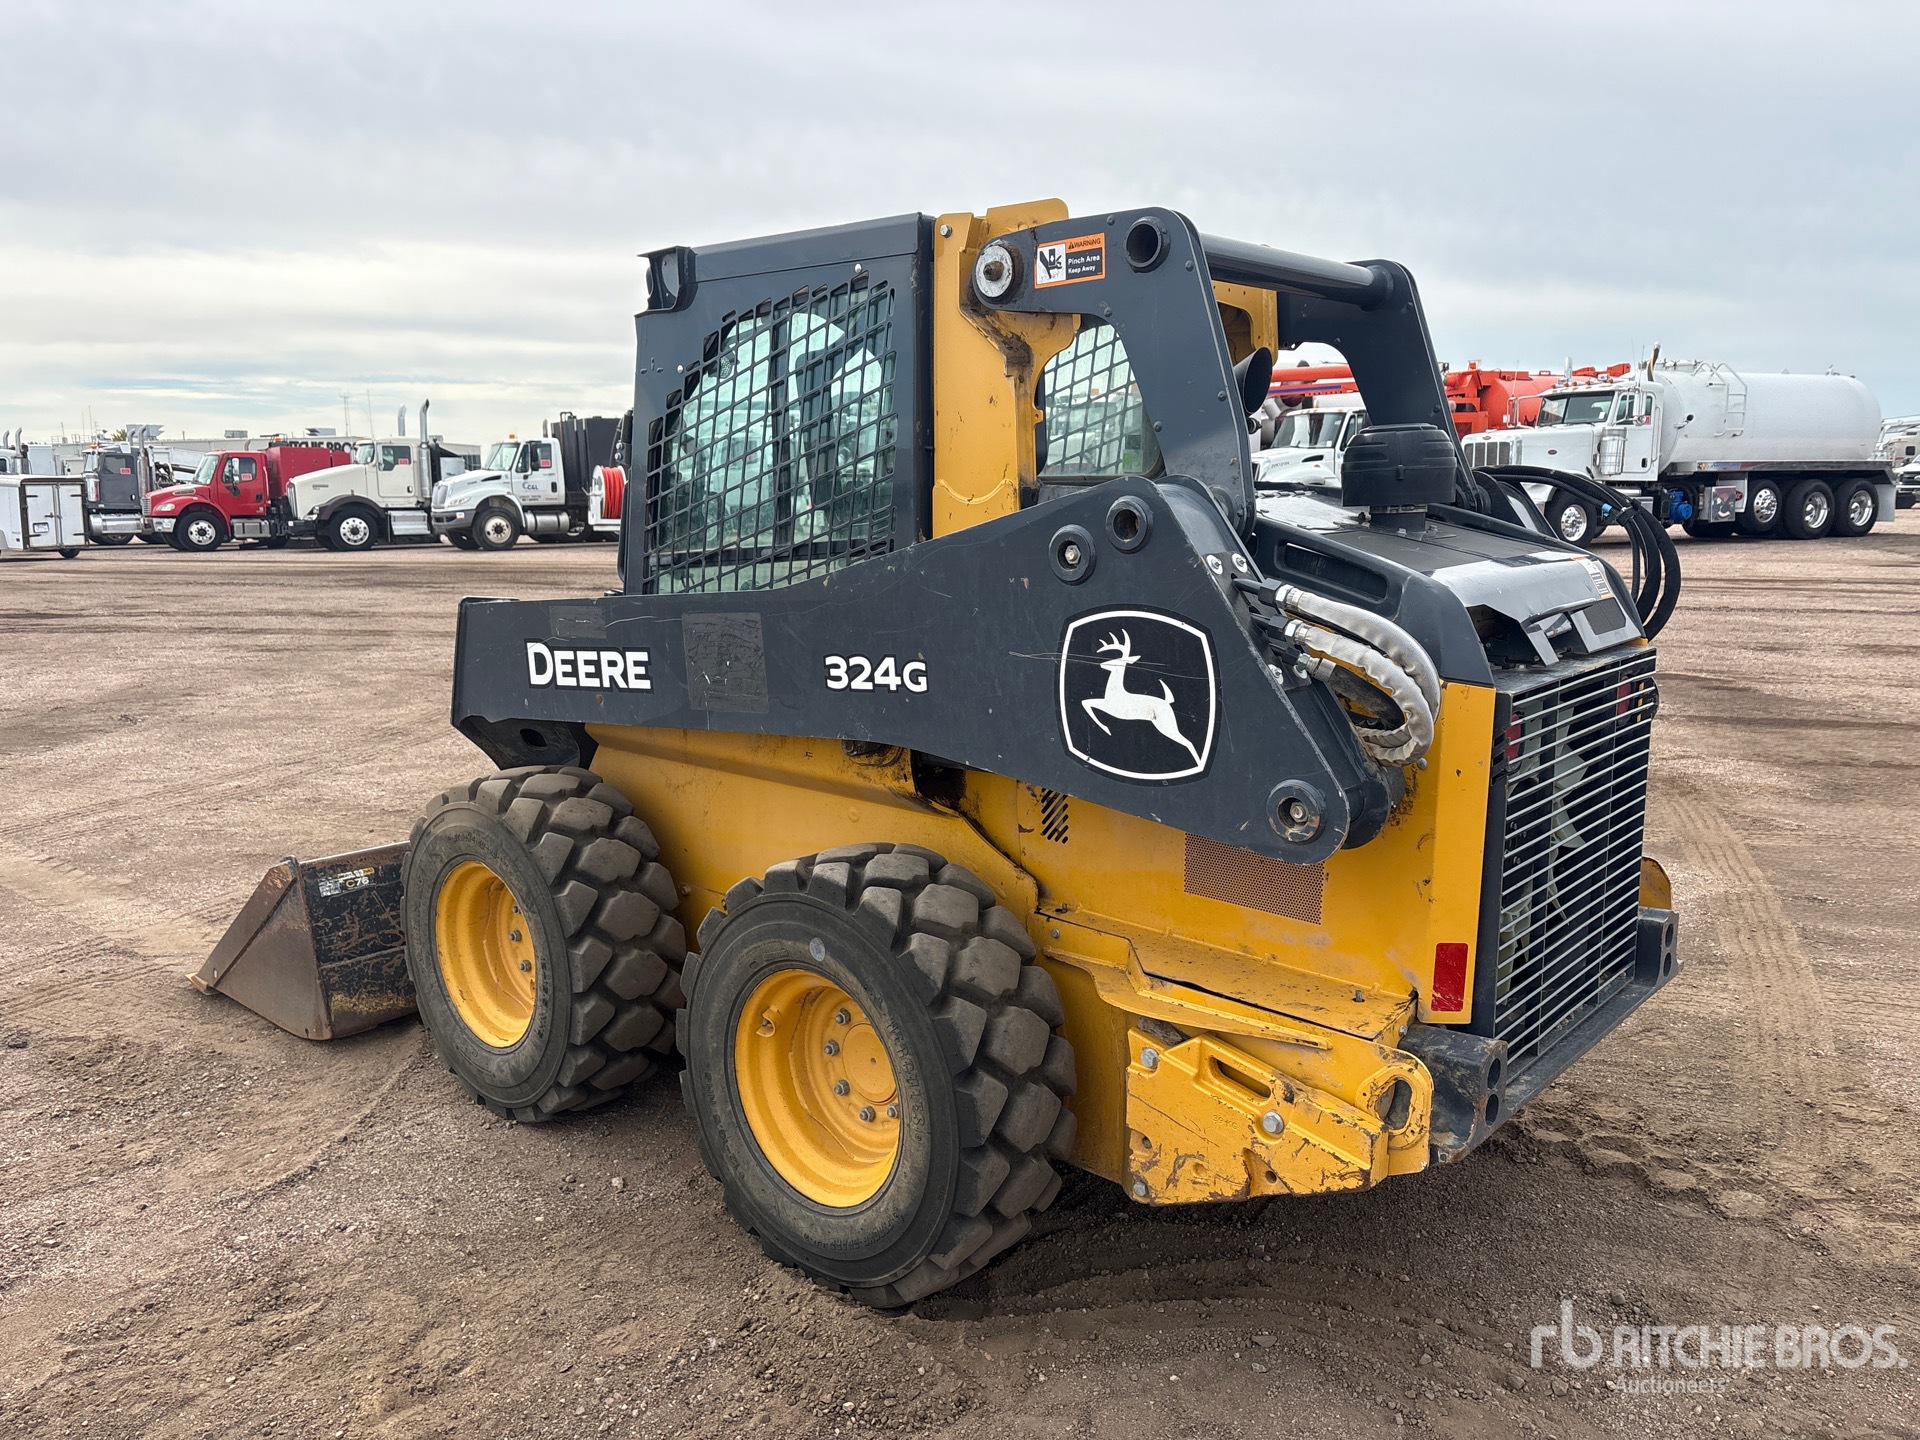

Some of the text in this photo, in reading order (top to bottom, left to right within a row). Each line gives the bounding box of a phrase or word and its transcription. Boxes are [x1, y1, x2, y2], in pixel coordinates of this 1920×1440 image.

[1074, 238, 1101, 247] WARNING
[1068, 255, 1100, 265] Pinch Area
[526, 641, 652, 690] DEERE
[824, 655, 928, 693] 324G
